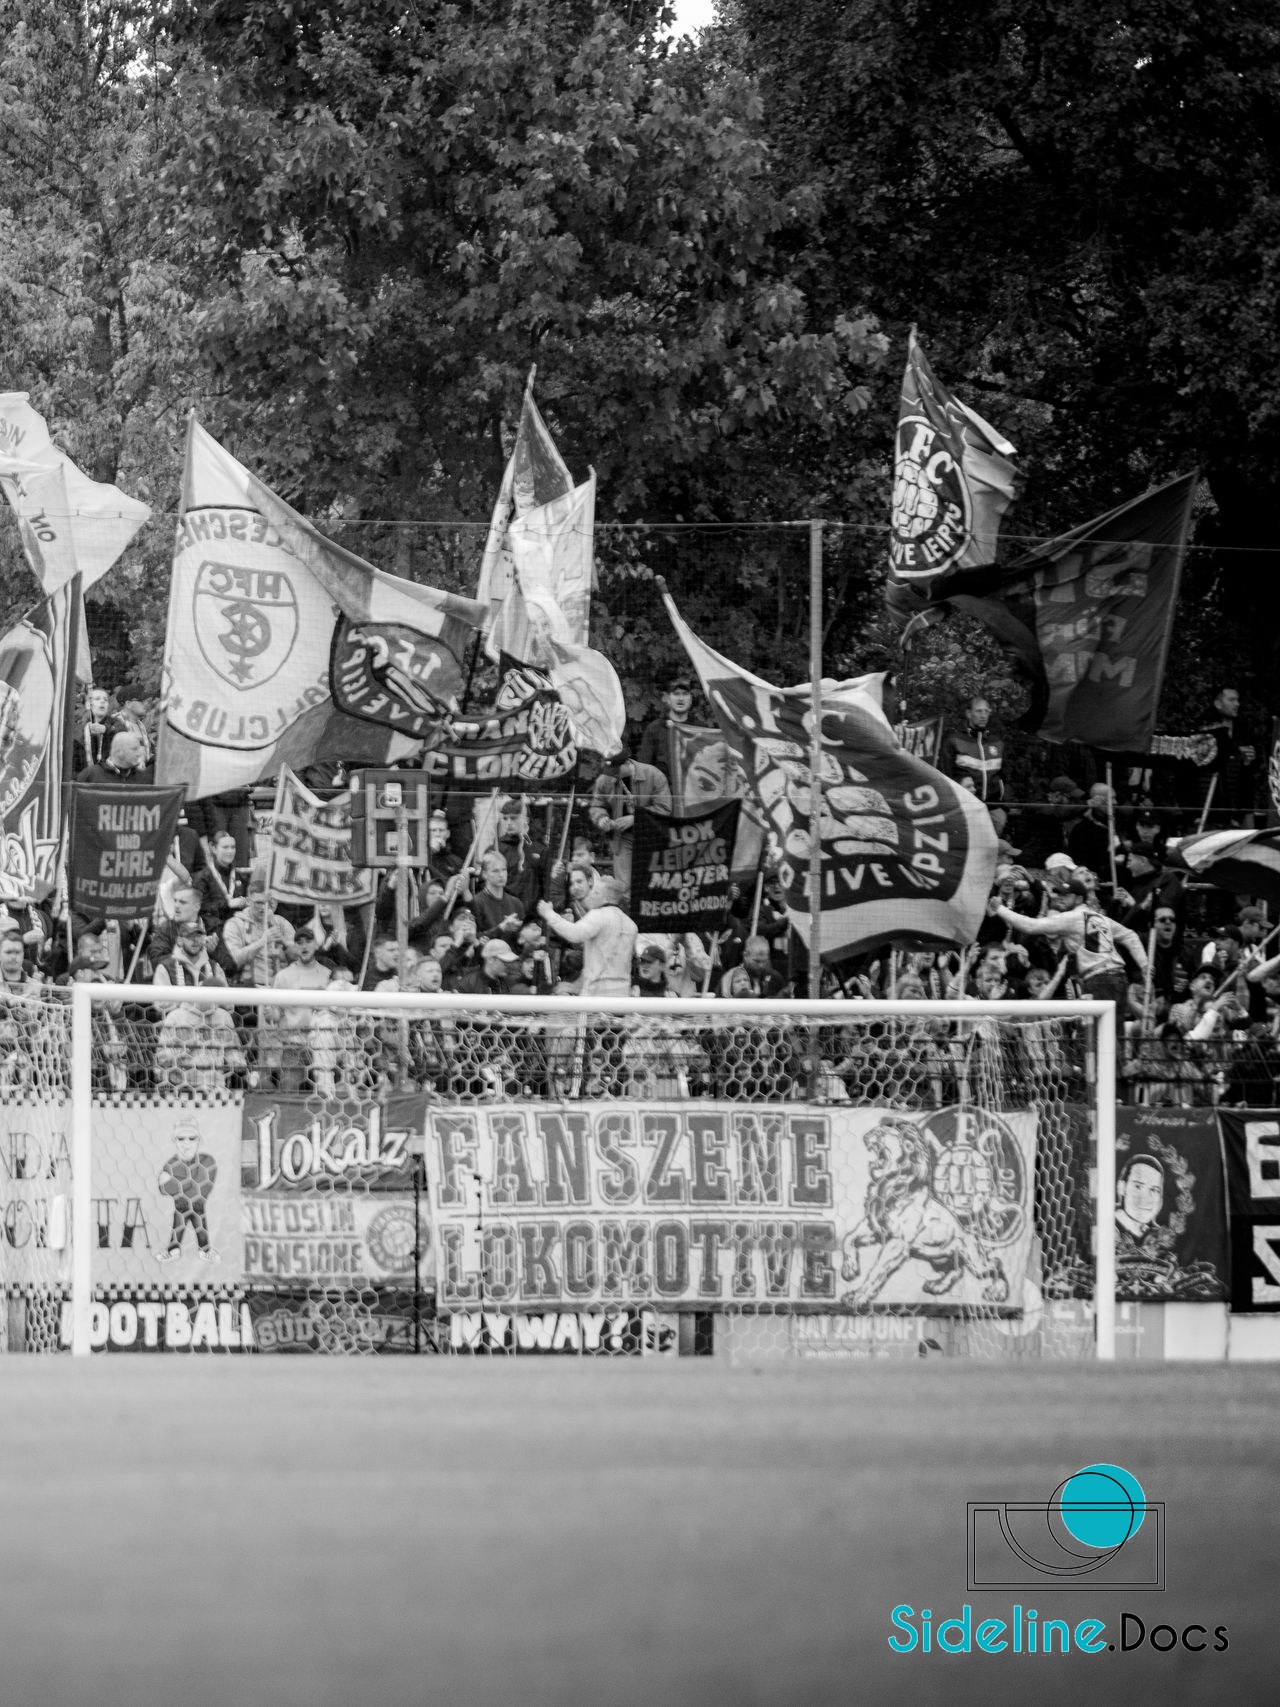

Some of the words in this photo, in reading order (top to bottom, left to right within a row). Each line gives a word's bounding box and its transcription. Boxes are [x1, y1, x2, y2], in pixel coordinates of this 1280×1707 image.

[98, 804, 160, 832] RUHM
[116, 833, 141, 849] UND
[668, 820, 716, 848] LOK
[99, 850, 155, 877] EHRE
[648, 837, 727, 872] LEIPZIG
[648, 864, 729, 890] MASTER
[678, 886, 700, 902] OF
[430, 1110, 833, 1208] FANSZENE
[440, 1219, 837, 1301] LOKOMOTIVE
